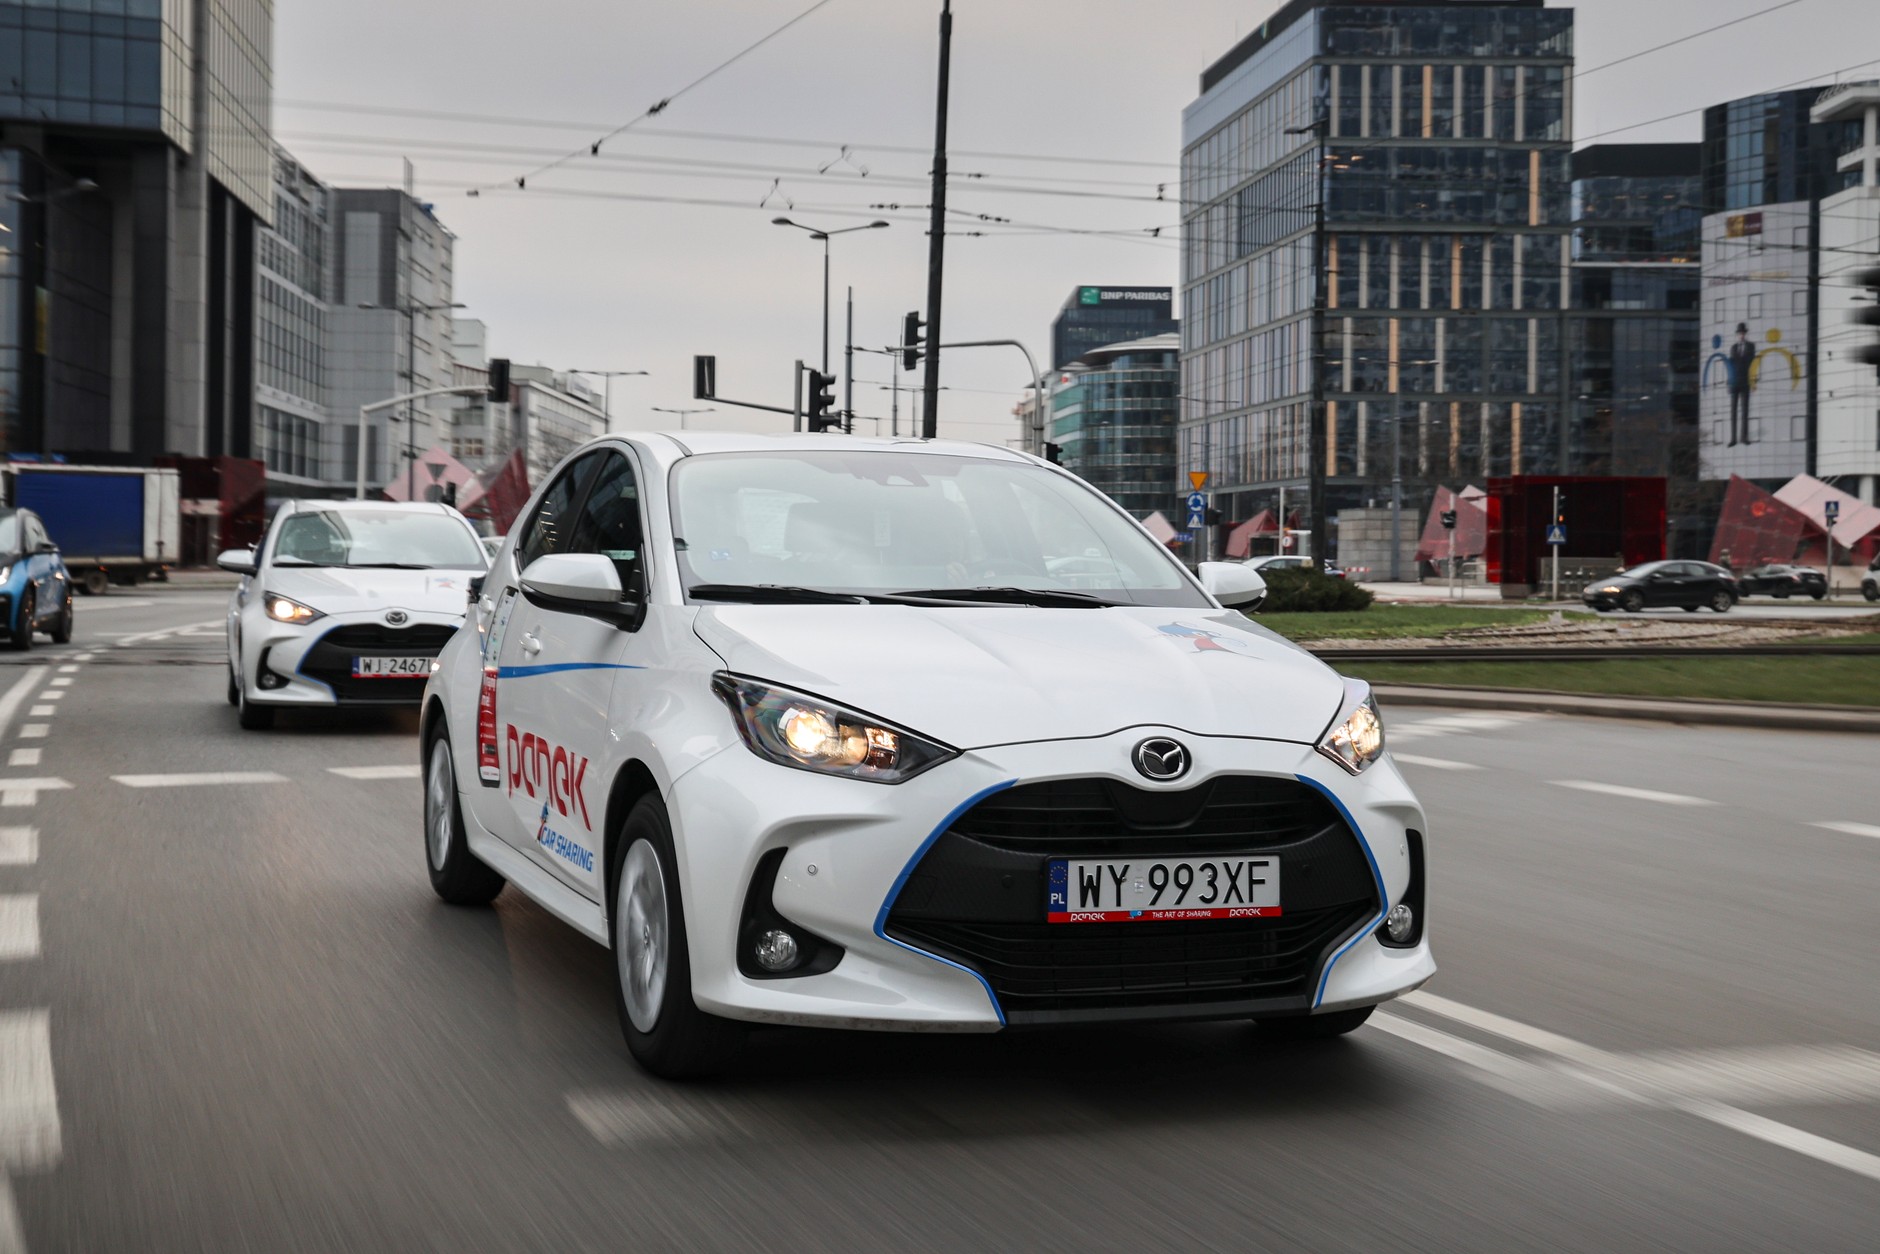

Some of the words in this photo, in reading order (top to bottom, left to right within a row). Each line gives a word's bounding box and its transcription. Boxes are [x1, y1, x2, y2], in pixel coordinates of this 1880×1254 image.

[1101, 291, 1123, 300] BNP
[1124, 291, 1170, 301] PARIBAS
[362, 658, 381, 673] WJ
[541, 826, 557, 850] CAR
[555, 834, 594, 873] SHARING
[1078, 863, 1130, 908] WY
[1148, 860, 1270, 907] 993XF
[1050, 892, 1065, 905] PL
[1152, 911, 1163, 919] THE
[1164, 911, 1176, 919] ART
[1177, 910, 1185, 918] OF
[1186, 910, 1212, 918] SHARING
